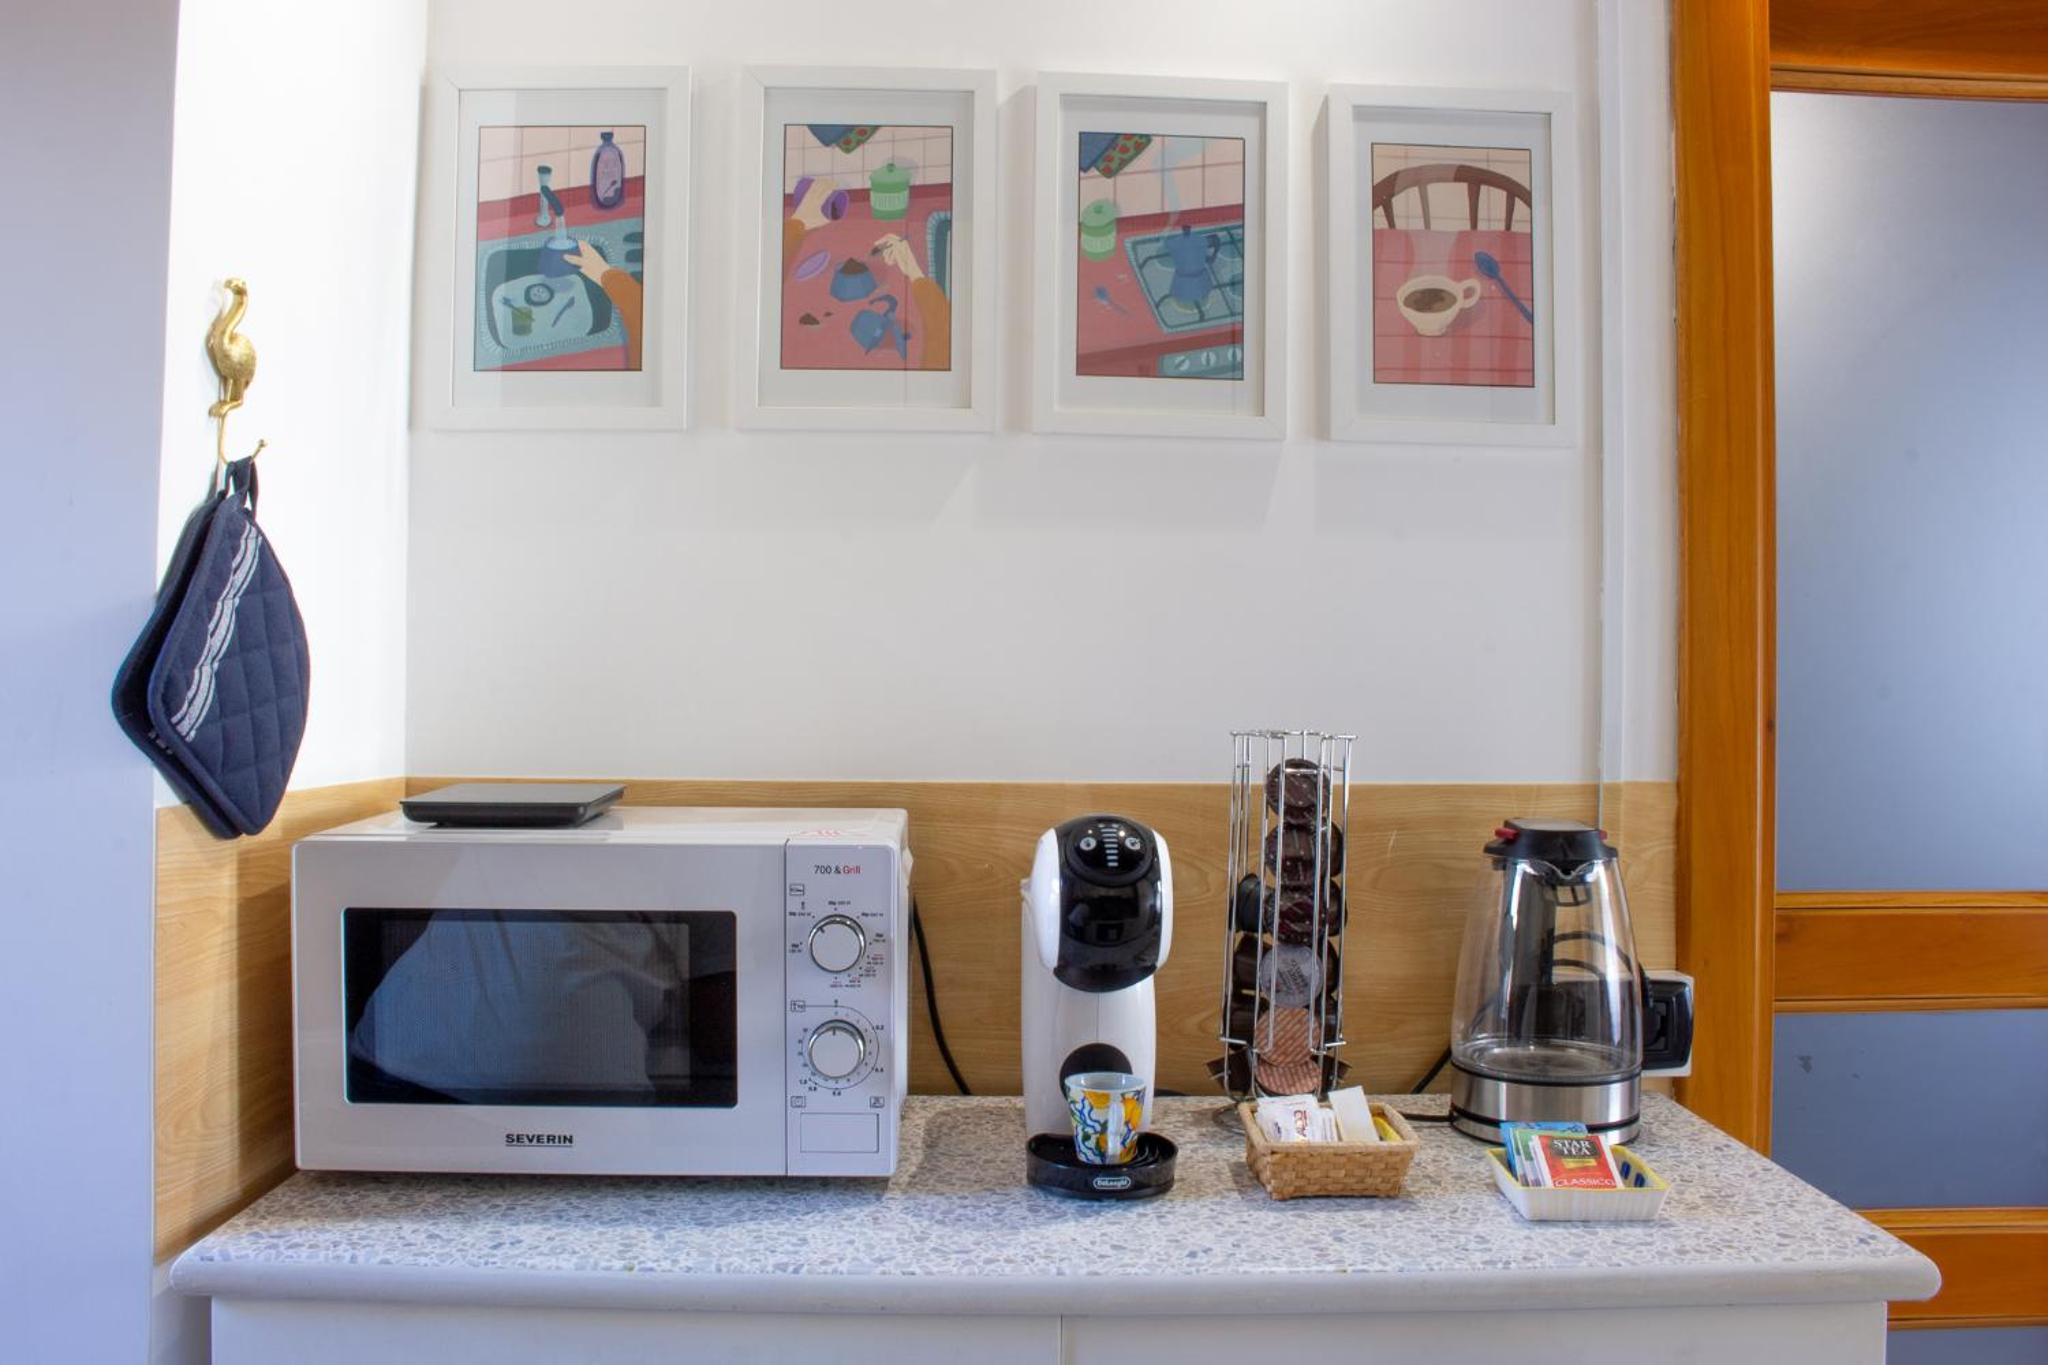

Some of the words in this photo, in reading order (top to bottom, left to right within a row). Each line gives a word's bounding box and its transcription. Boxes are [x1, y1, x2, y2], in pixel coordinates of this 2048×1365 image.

[814, 865, 832, 874] 700
[834, 865, 841, 874] &
[843, 865, 861, 874] Grill
[505, 1133, 573, 1144] SEVERIN
[1553, 1139, 1591, 1148] STAR
[1562, 1146, 1591, 1156] TEA
[1554, 1178, 1616, 1187] CLASSICO
